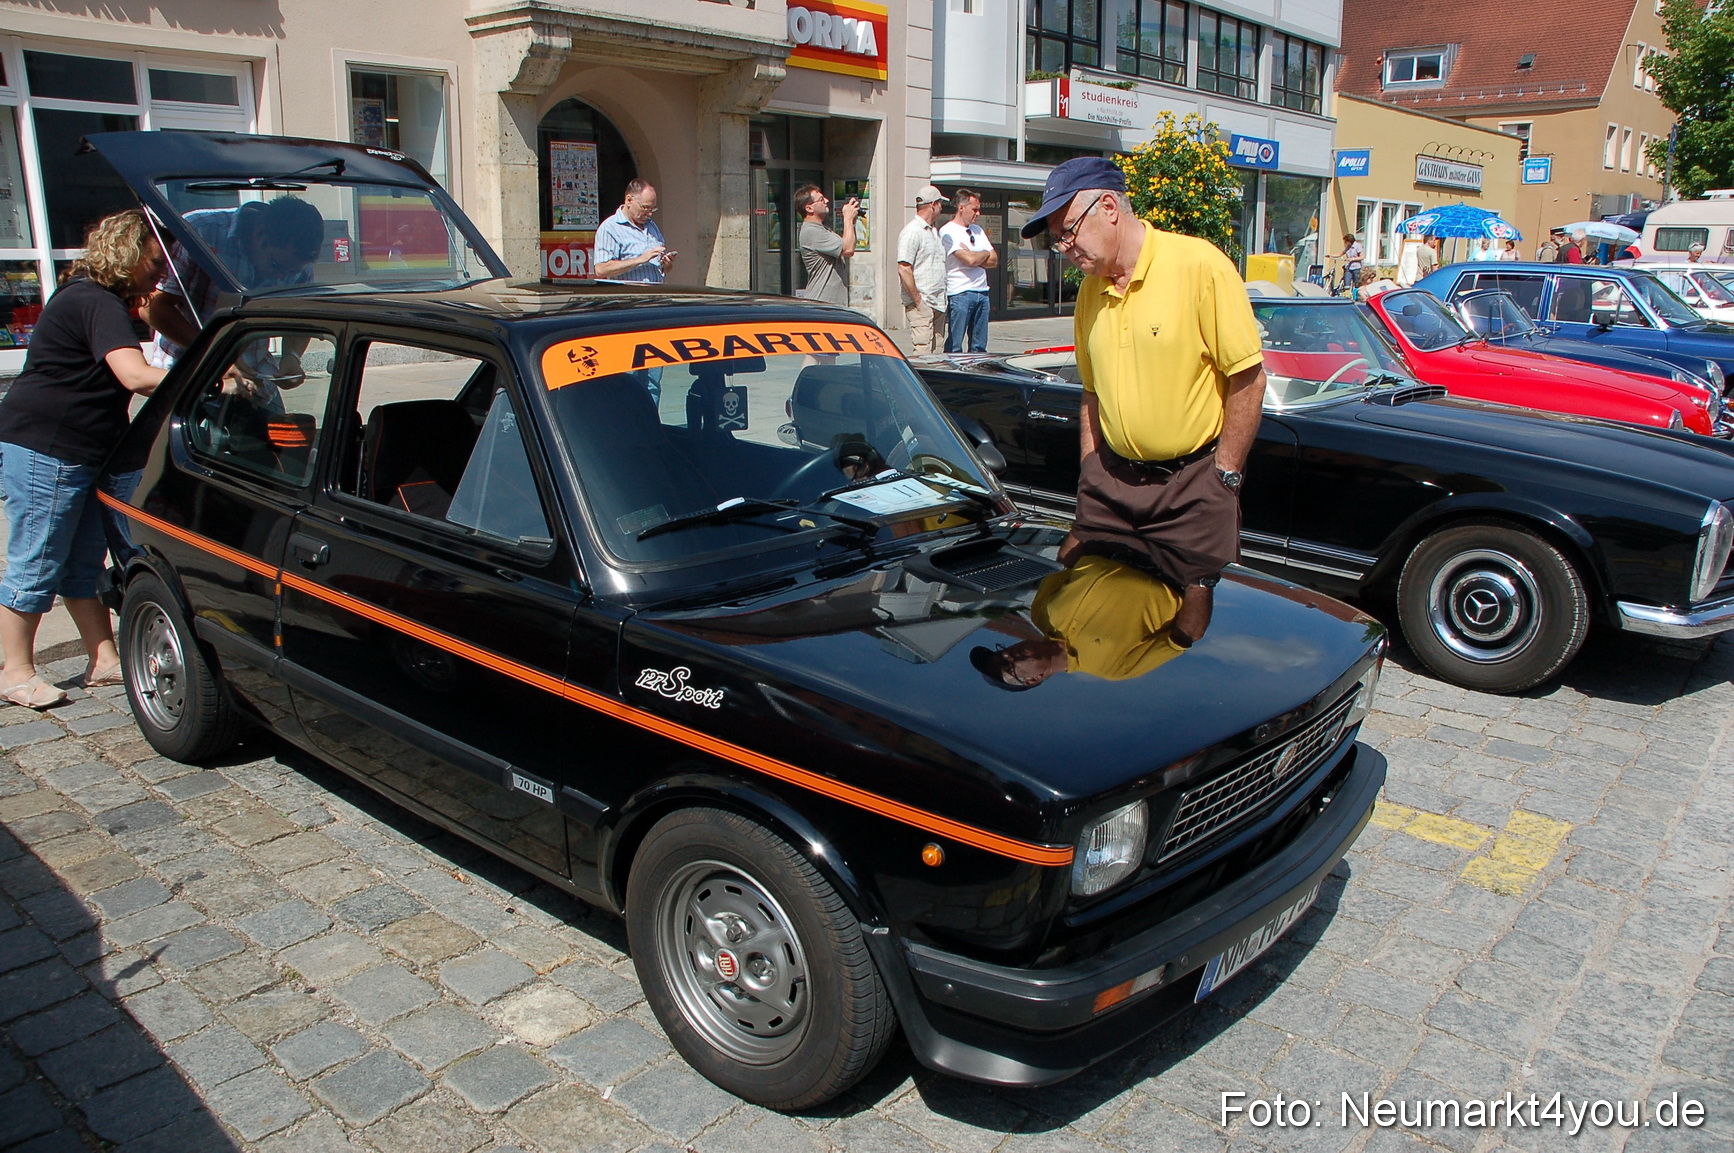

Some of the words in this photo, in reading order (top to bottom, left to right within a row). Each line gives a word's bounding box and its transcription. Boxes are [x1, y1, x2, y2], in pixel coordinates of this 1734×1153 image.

[788, 6, 878, 56] ORMA
[1081, 91, 1138, 109] studienkreis
[1338, 156, 1367, 167] APOLLO
[1418, 161, 1449, 179] GASTHAUS
[1466, 169, 1481, 184] GANS
[631, 332, 864, 369] ABARTH
[893, 484, 921, 498] 11
[635, 668, 669, 691] 127
[658, 666, 724, 709] Sport
[518, 777, 530, 791] 70
[532, 784, 547, 797] HP
[718, 955, 734, 975] FIAT
